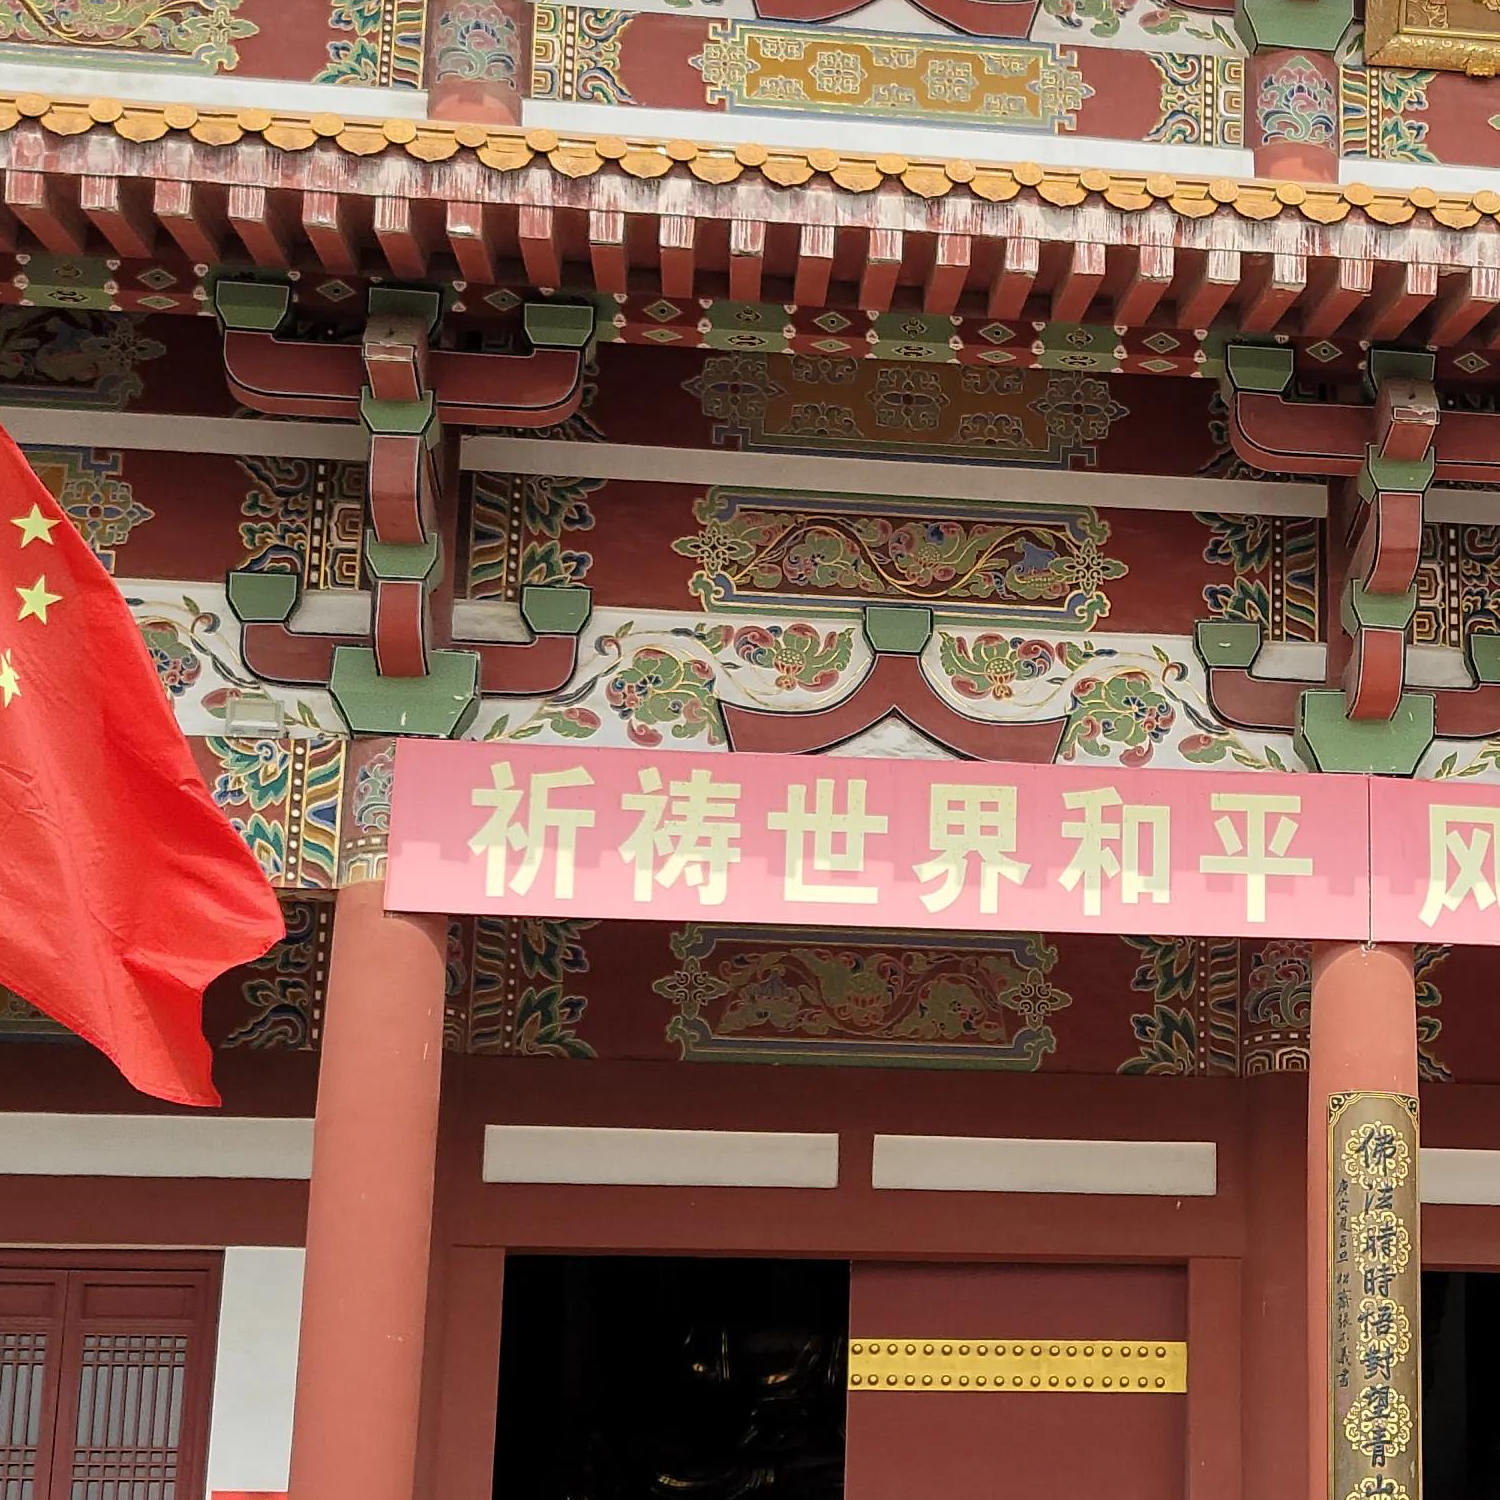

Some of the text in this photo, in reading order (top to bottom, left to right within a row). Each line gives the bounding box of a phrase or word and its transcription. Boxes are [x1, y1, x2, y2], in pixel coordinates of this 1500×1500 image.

[469, 761, 1315, 923] 祈祷世界和平
